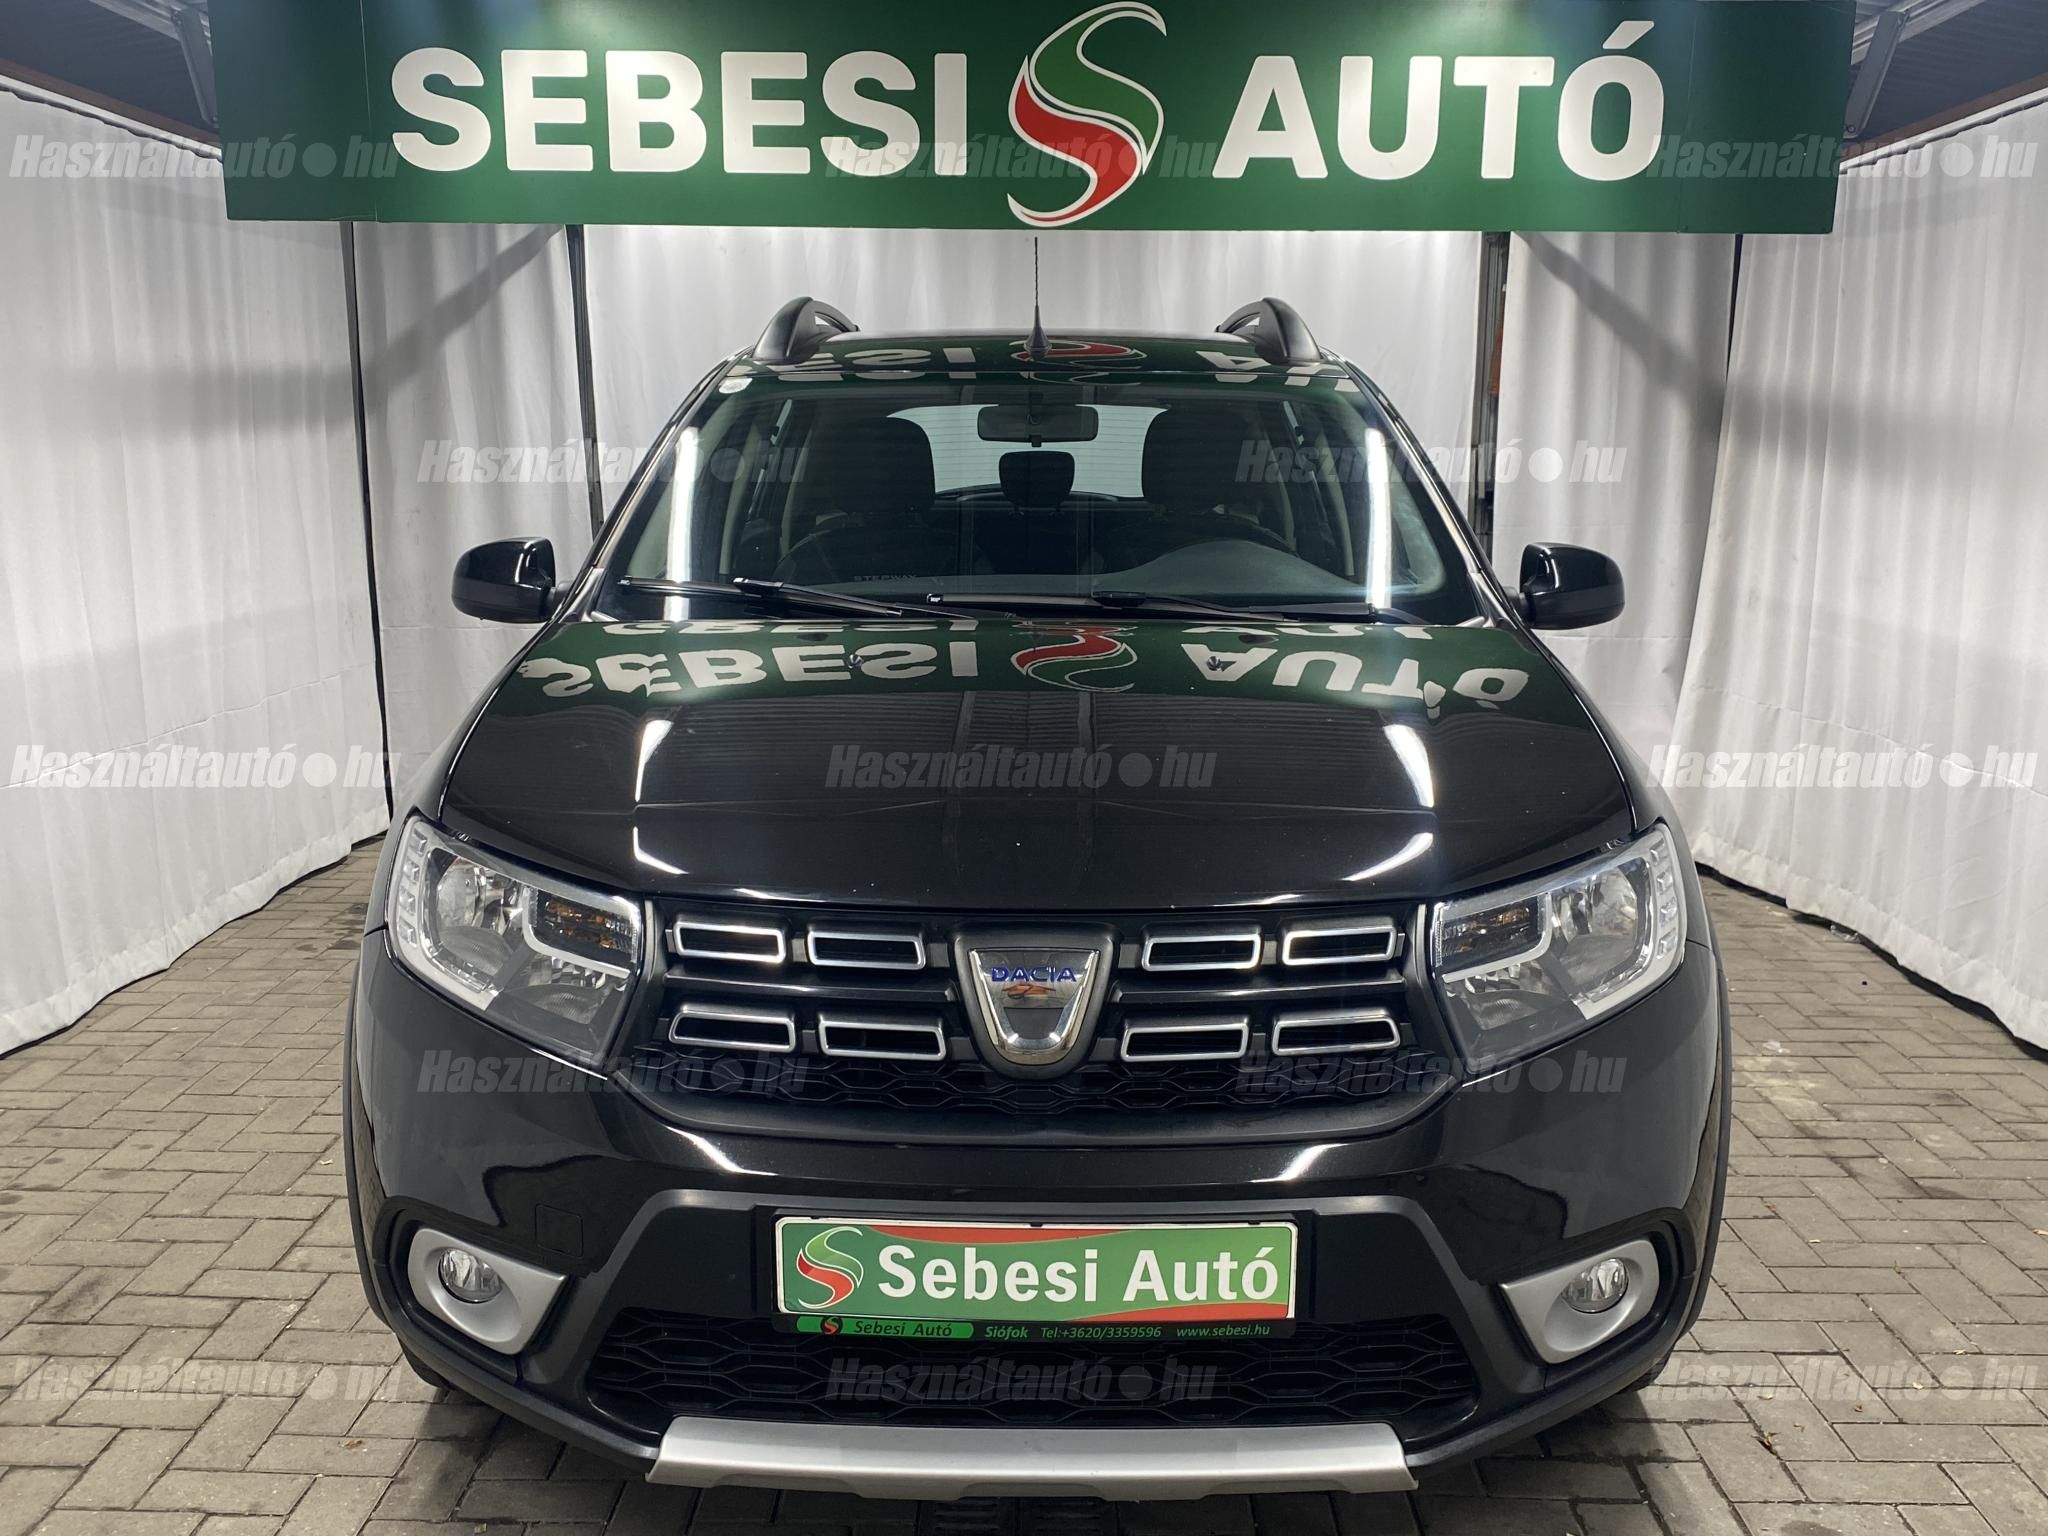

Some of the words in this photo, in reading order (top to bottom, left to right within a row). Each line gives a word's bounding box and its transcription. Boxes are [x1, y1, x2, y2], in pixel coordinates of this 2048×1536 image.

[391, 47, 967, 175] SEBESI
[1212, 20, 1664, 181] AUTÓ
[991, 967, 1077, 982] DACIA
[878, 1245, 1100, 1302] Sebesi
[1122, 1246, 1279, 1301] Autó
[853, 1320, 906, 1335] Sebesi
[912, 1323, 953, 1337] Autó
[985, 1326, 1029, 1340] Siófok
[1176, 1324, 1271, 1337] www.sebesi.hu
